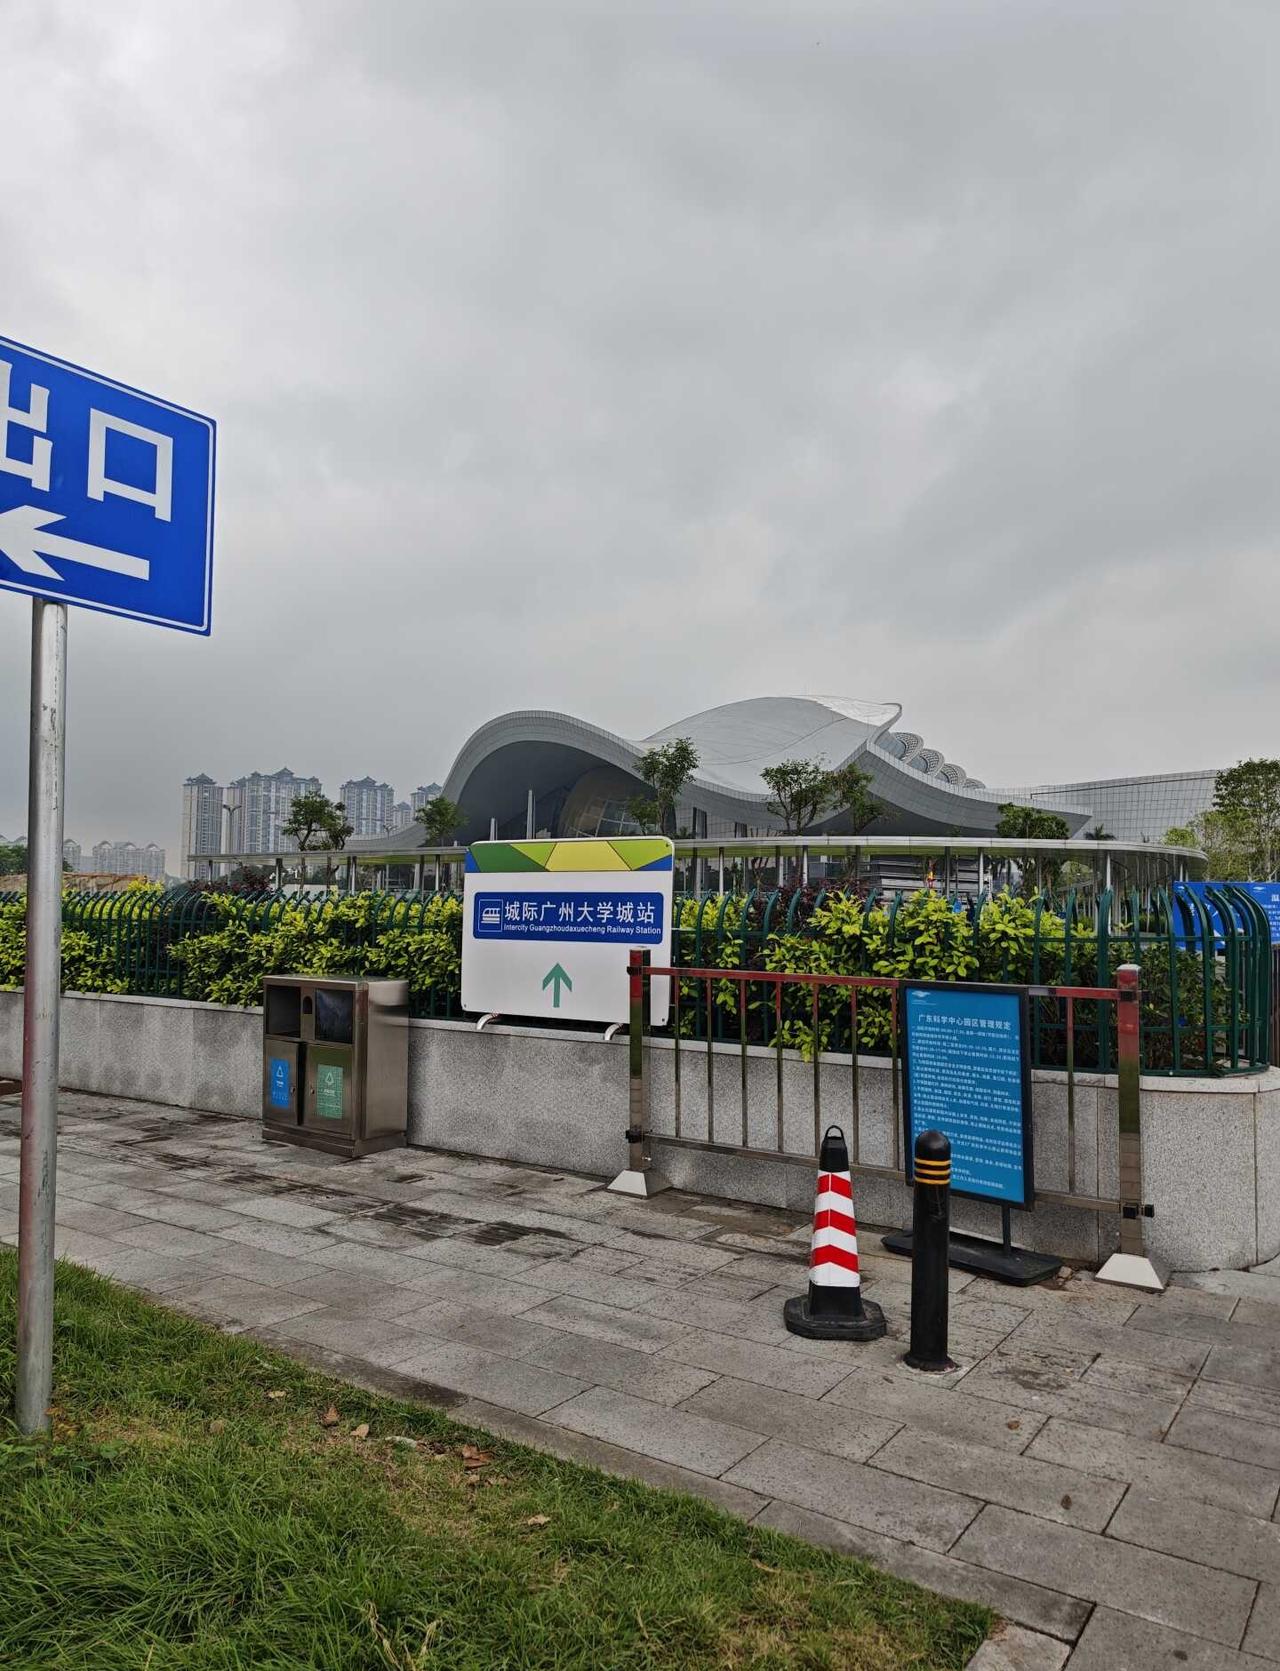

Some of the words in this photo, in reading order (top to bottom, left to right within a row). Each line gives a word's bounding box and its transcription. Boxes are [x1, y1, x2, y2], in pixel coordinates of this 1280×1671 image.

[504, 901, 655, 923] 城际广州大学城站
[503, 923, 528, 933] Intercity
[529, 924, 605, 935] Guangzhoudaxuecheng
[606, 925, 634, 935] Railway
[635, 926, 661, 935] Station
